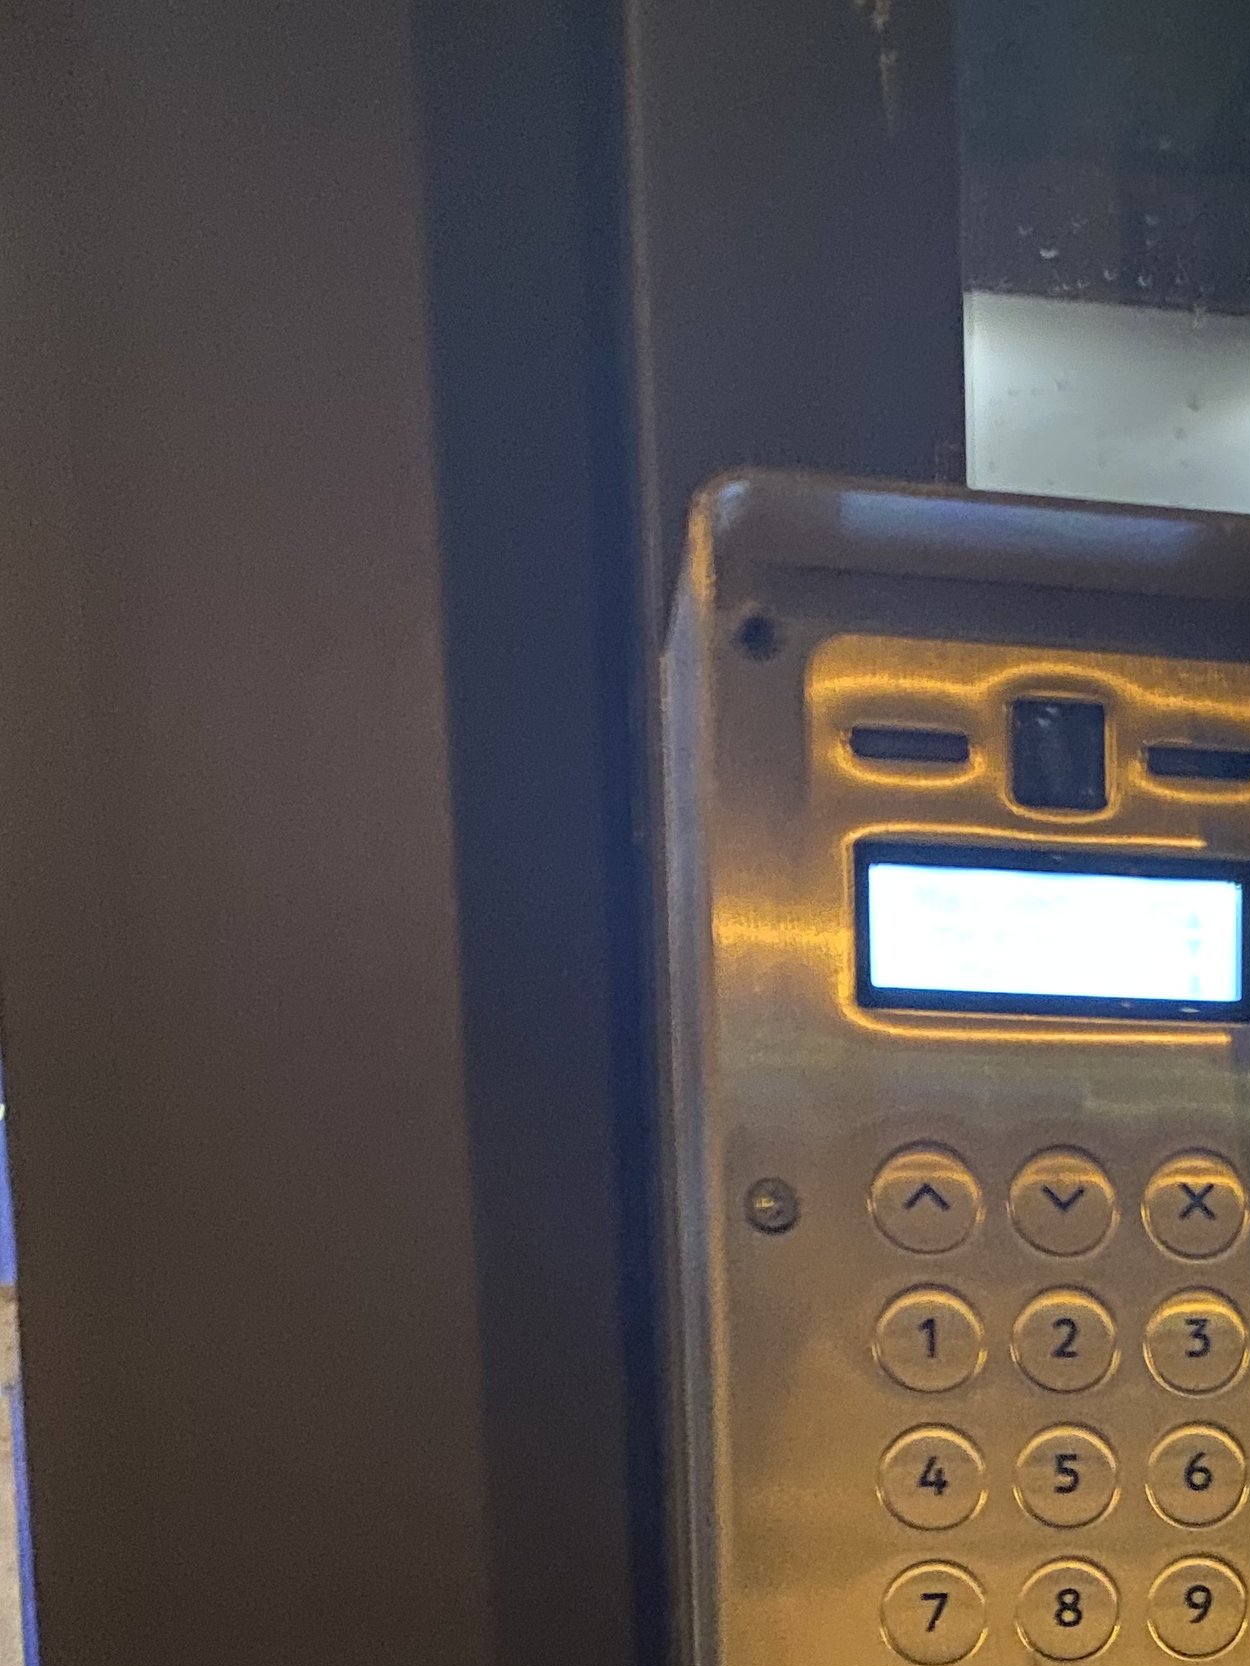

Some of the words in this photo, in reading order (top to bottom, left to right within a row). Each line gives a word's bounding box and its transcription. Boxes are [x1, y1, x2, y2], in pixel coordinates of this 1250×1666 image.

[919, 1318, 936, 1358] 1
[1051, 1318, 1079, 1358] 2
[1185, 1319, 1211, 1358] 3
[919, 1456, 948, 1495] 4
[1055, 1454, 1079, 1494] 5
[1184, 1452, 1213, 1491] 6
[921, 1593, 948, 1632] 7
[1055, 1588, 1082, 1627] 8
[1185, 1585, 1212, 1623] 9
